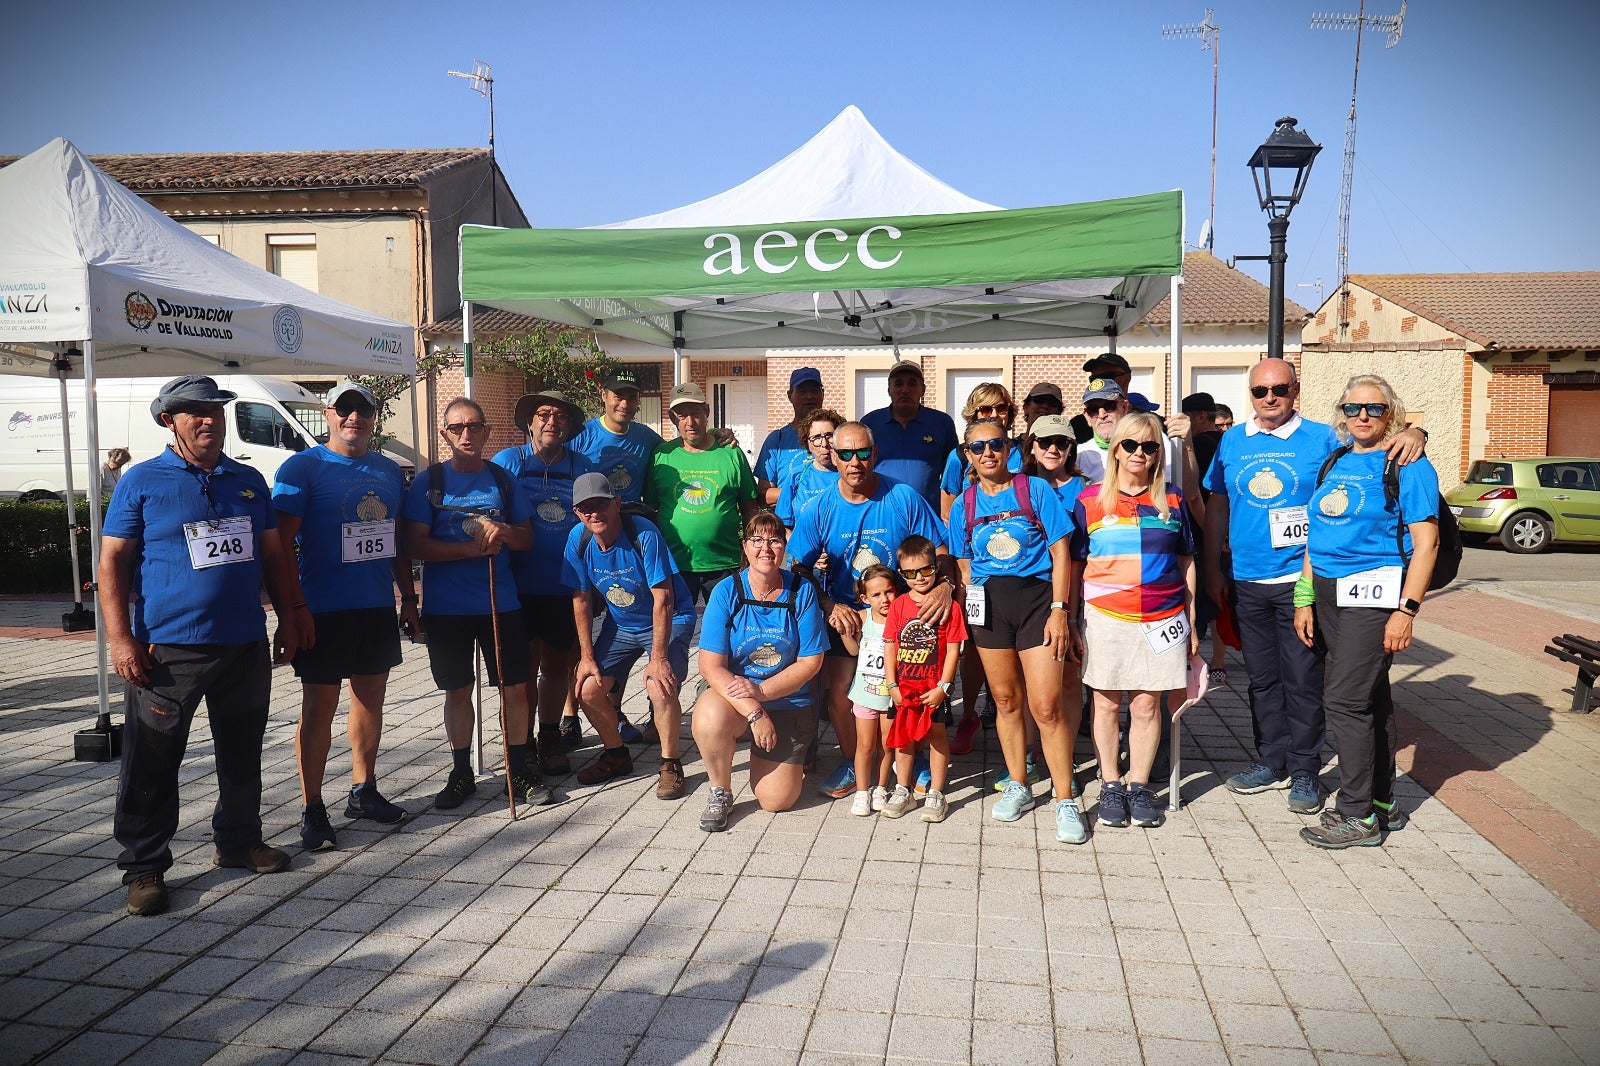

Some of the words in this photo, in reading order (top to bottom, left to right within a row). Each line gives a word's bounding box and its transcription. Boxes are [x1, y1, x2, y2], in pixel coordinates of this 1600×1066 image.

[703, 225, 903, 276] aecc
[158, 322, 172, 335] DE
[174, 321, 233, 340] VALLADOLID
[365, 337, 402, 355] AVANZA
[36, 411, 77, 422] RUNVASRT
[1283, 523, 1309, 539] 409
[205, 537, 243, 559] 248
[355, 538, 384, 555] 185
[1349, 584, 1383, 599] 410
[967, 603, 980, 618] 206
[1160, 620, 1184, 644] 199
[897, 648, 929, 664] SPEED
[901, 664, 937, 678] KING
